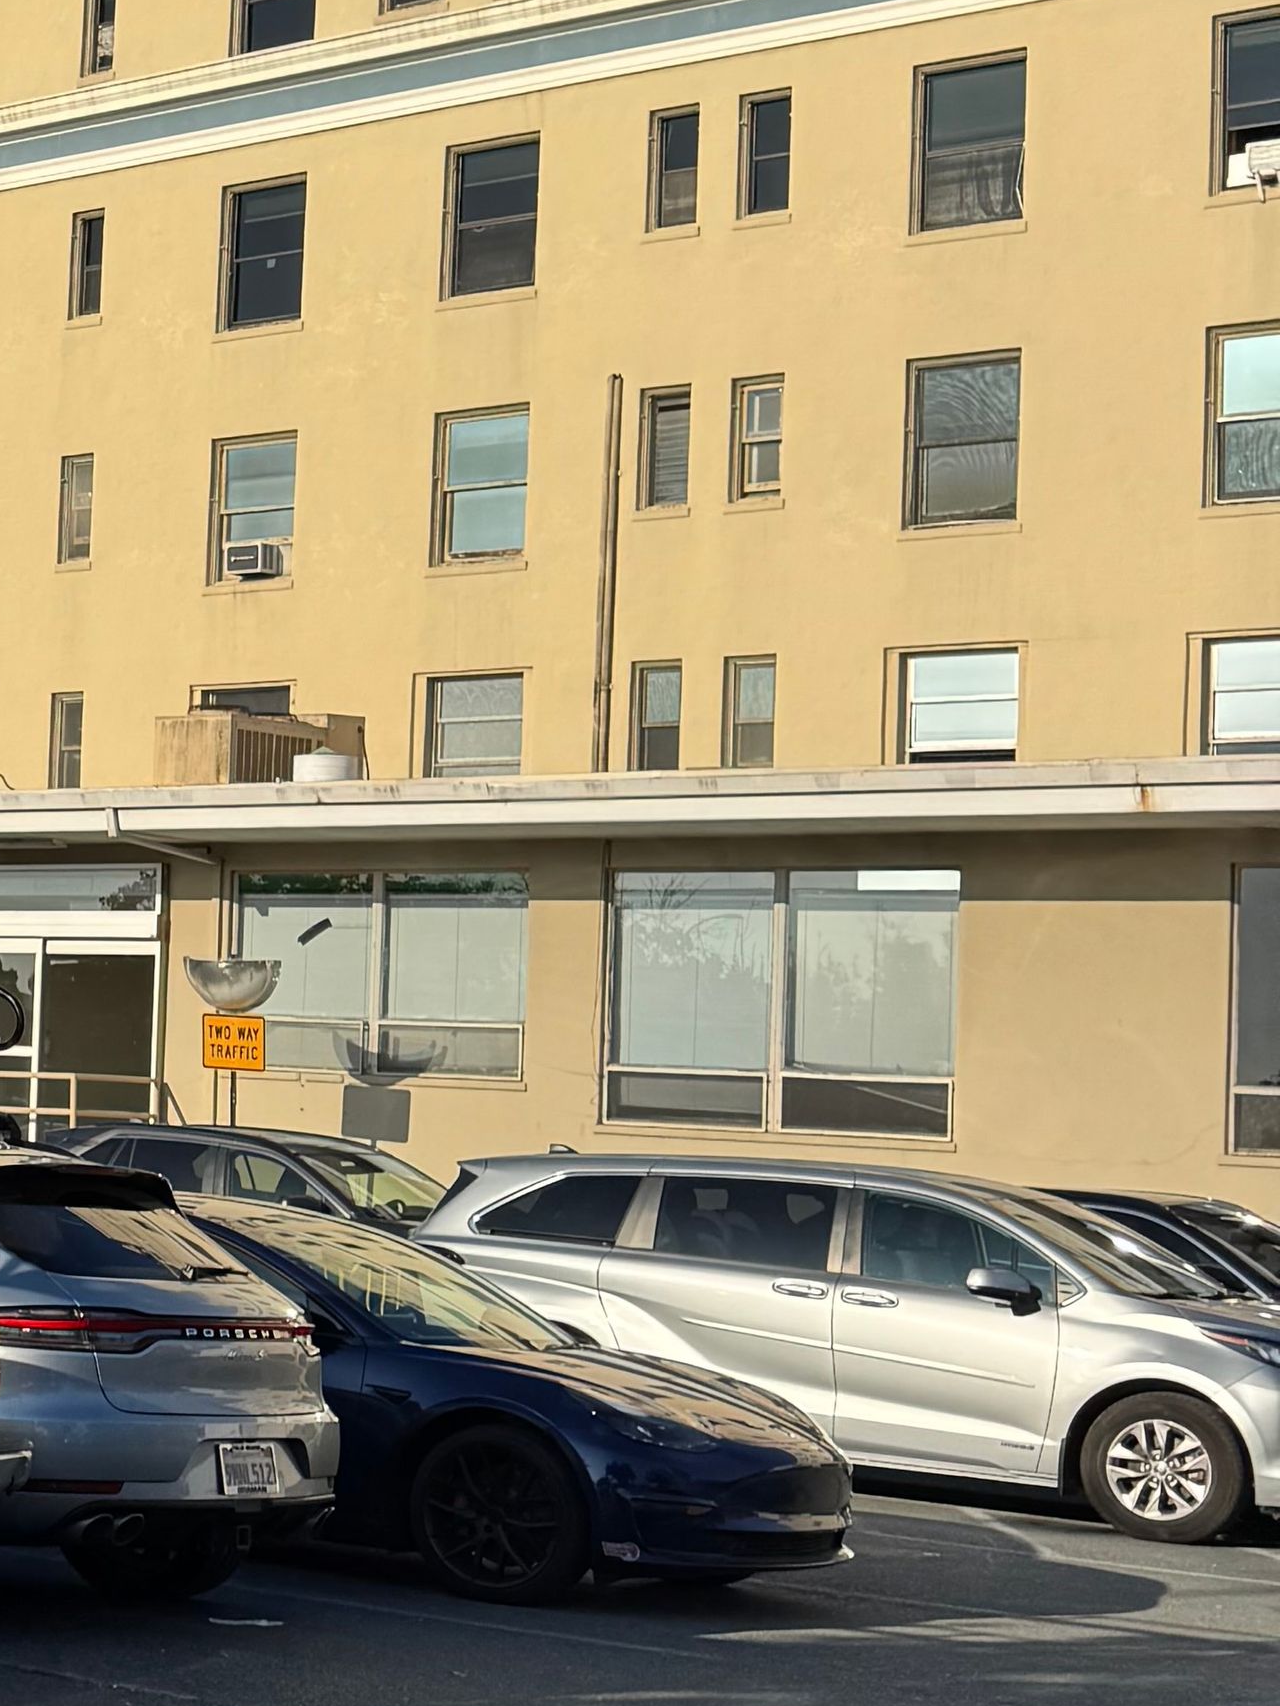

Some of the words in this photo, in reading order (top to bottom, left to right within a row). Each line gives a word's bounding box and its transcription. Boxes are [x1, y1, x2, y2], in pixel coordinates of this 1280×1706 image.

[208, 1024, 231, 1040] TWO
[237, 1026, 259, 1042] WAY
[210, 1043, 258, 1061] TRAFFIC
[185, 1327, 282, 1339] PORSCHE
